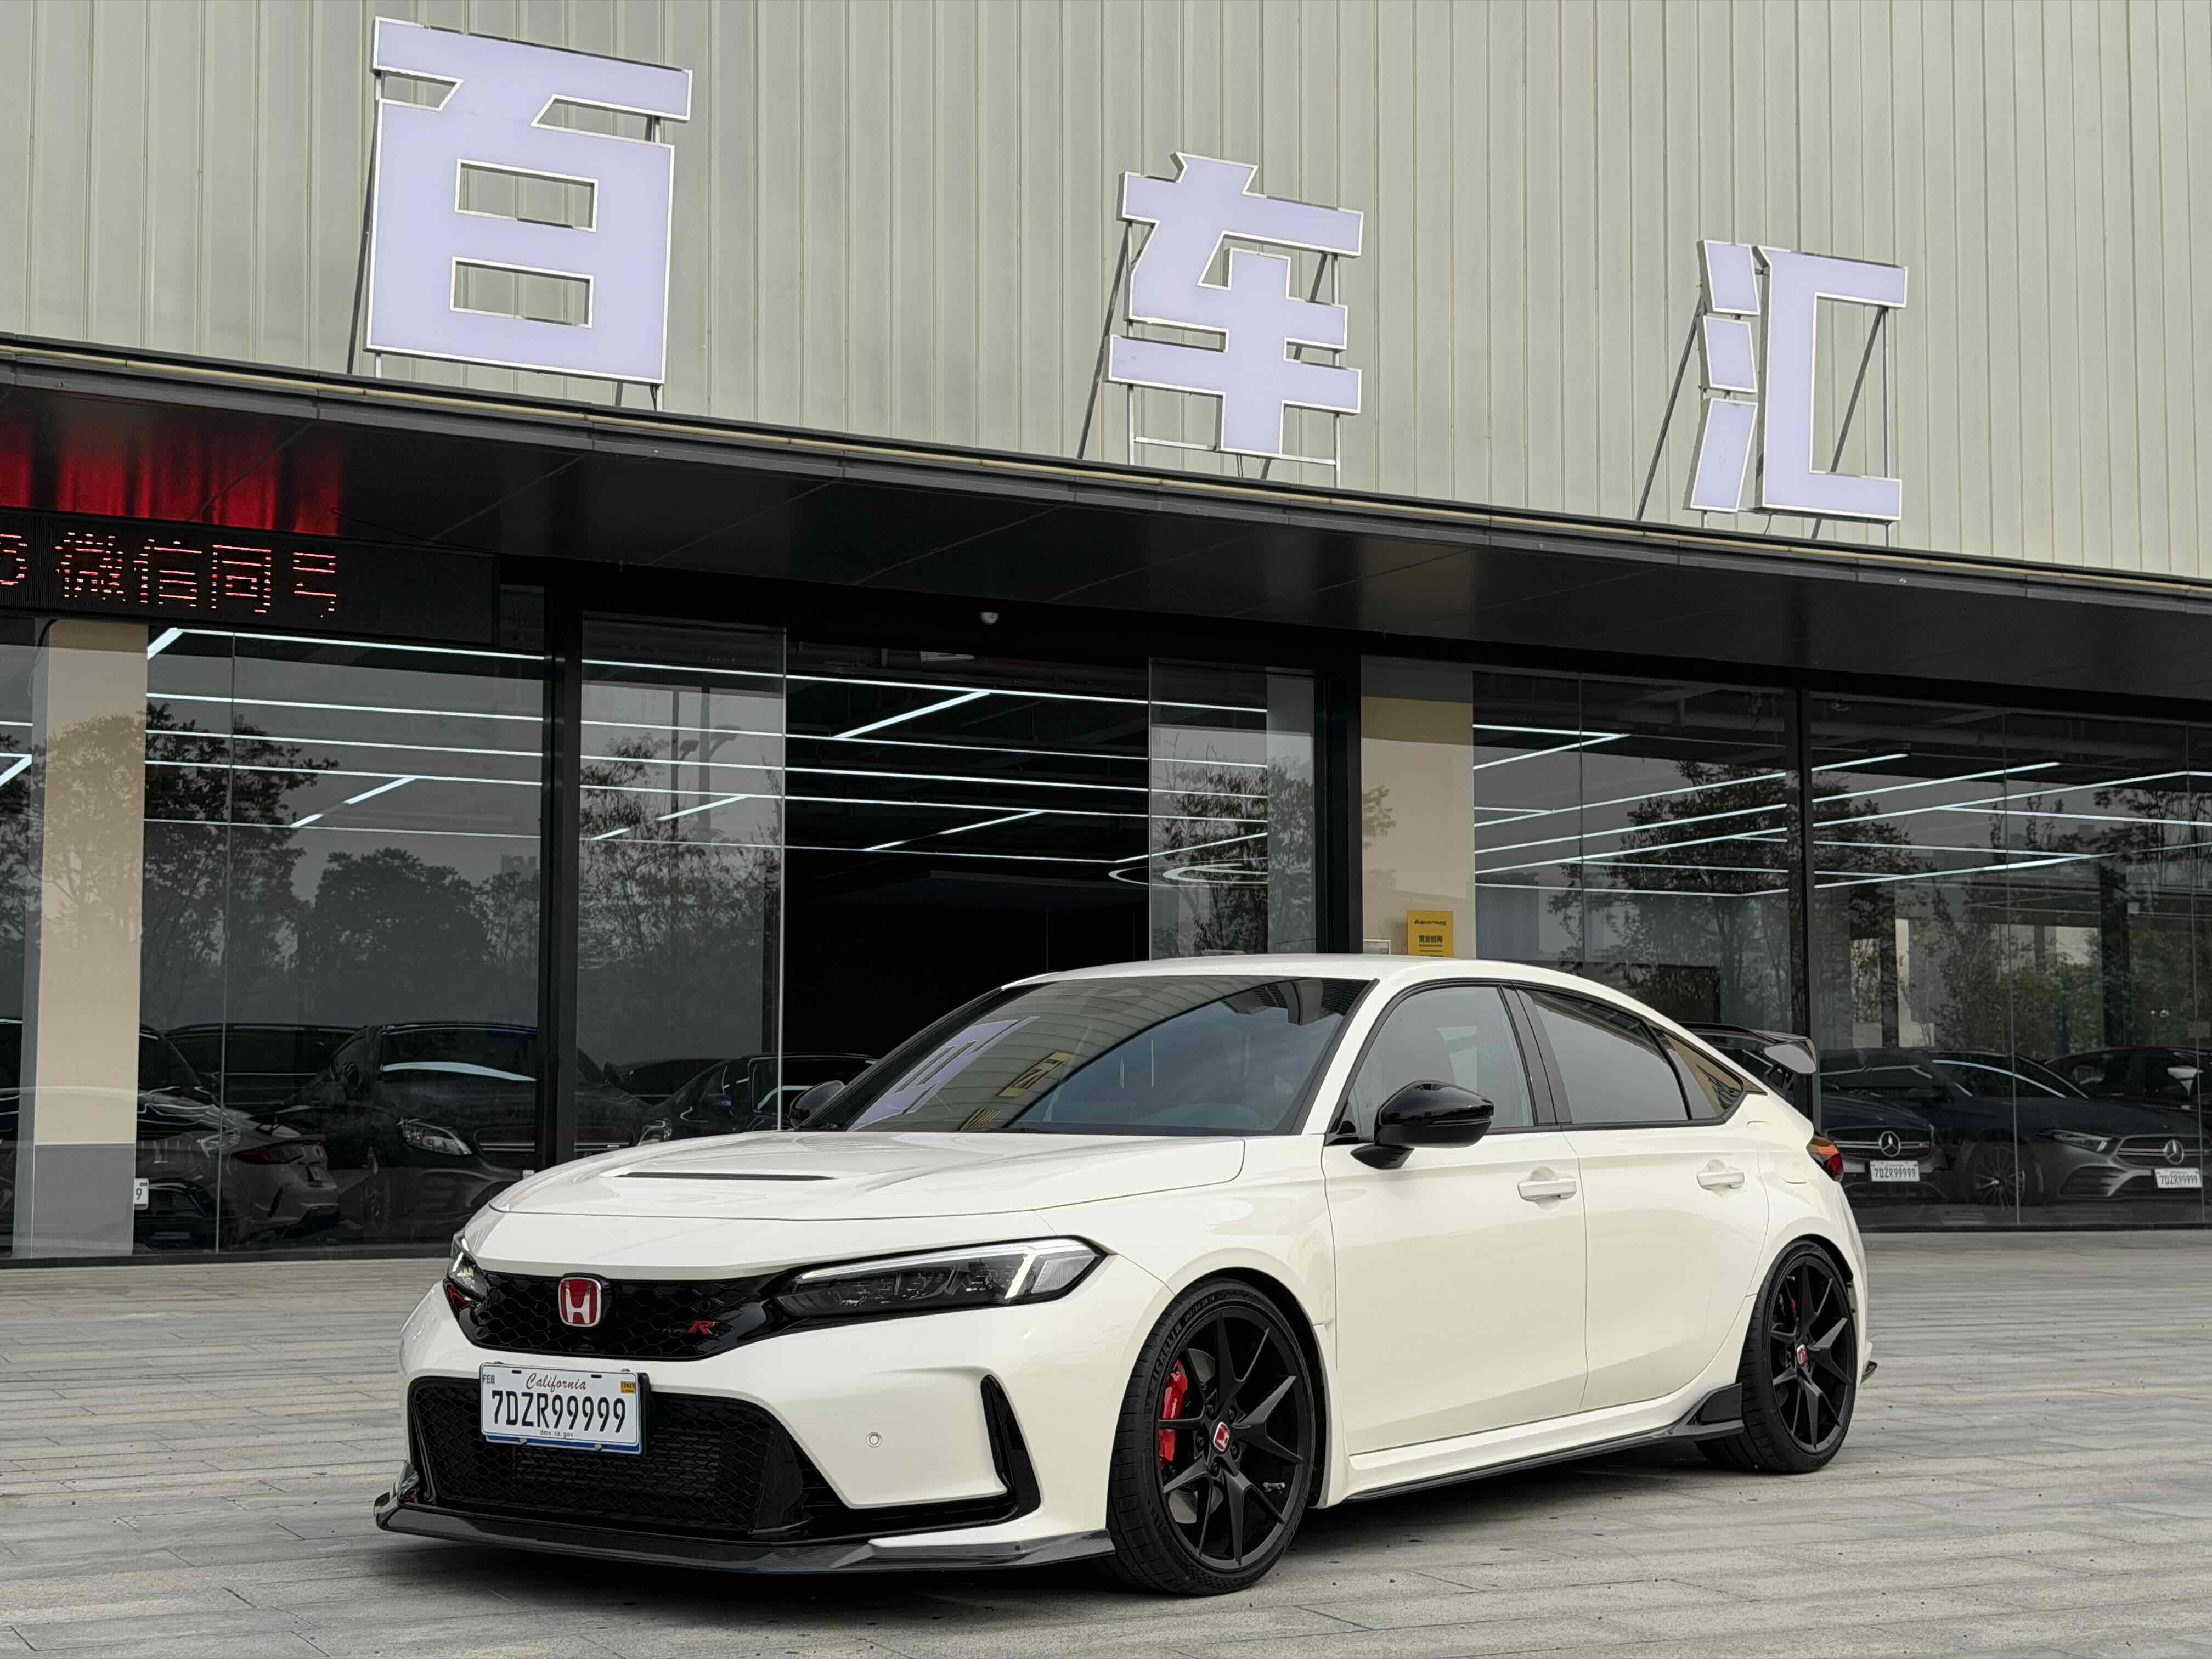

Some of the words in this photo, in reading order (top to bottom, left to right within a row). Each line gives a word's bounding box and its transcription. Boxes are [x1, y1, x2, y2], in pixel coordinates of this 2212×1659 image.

[363, 15, 1908, 521] 百车汇
[55, 532, 337, 618] 微信同号
[483, 1374, 495, 1384] FEB
[526, 1372, 588, 1392] California
[491, 1389, 625, 1433] 7DZR99999
